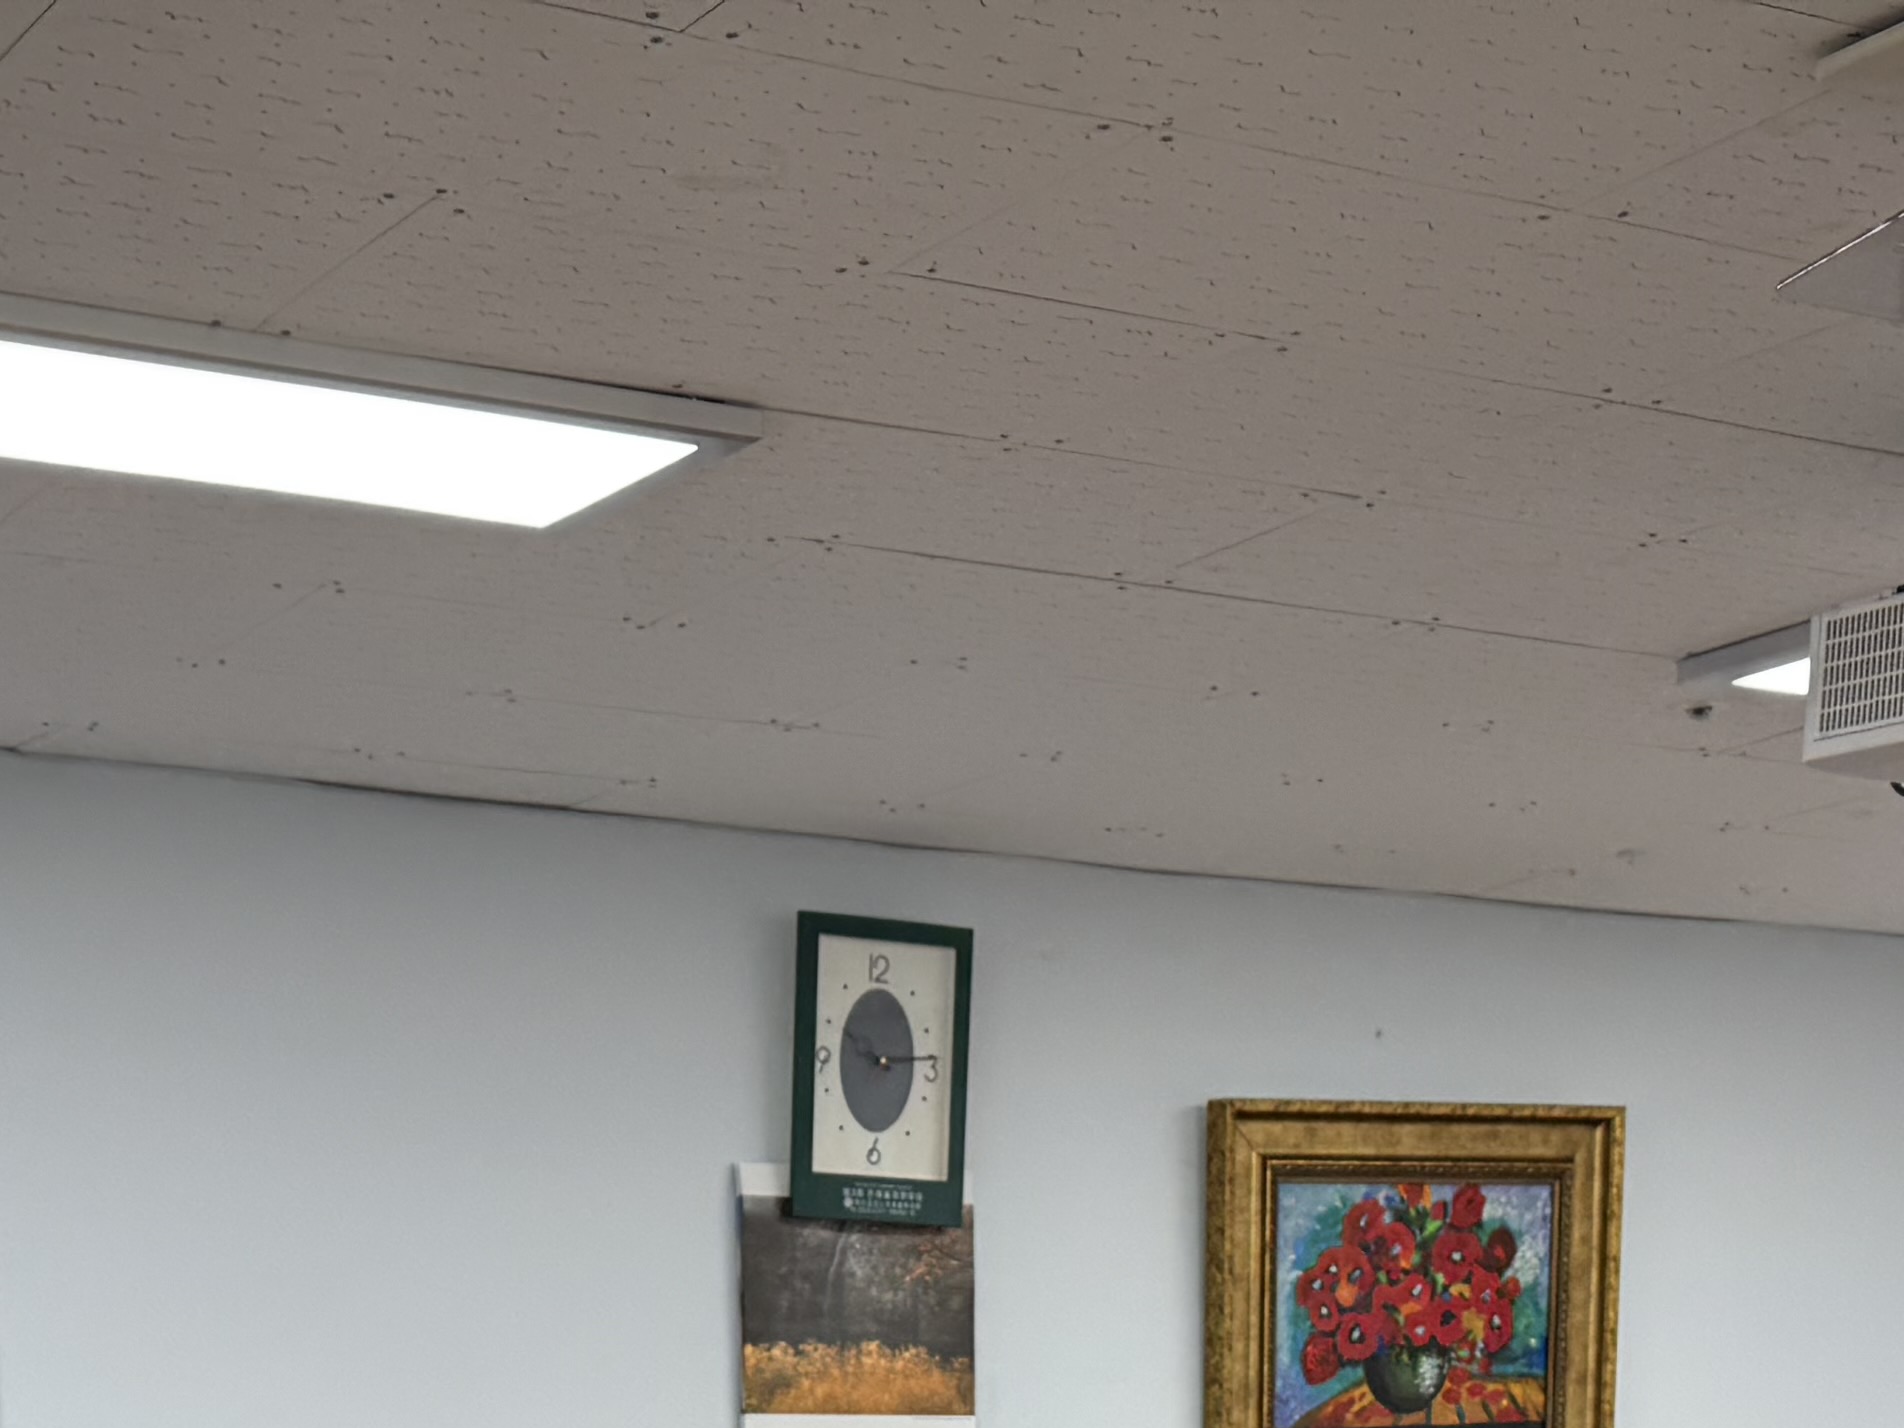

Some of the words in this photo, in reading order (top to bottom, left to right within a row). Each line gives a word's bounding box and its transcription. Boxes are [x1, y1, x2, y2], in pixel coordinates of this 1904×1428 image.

[868, 953, 890, 983] 12
[816, 1046, 831, 1073] 9
[924, 1054, 938, 1083] 3
[866, 1137, 881, 1165] 6
